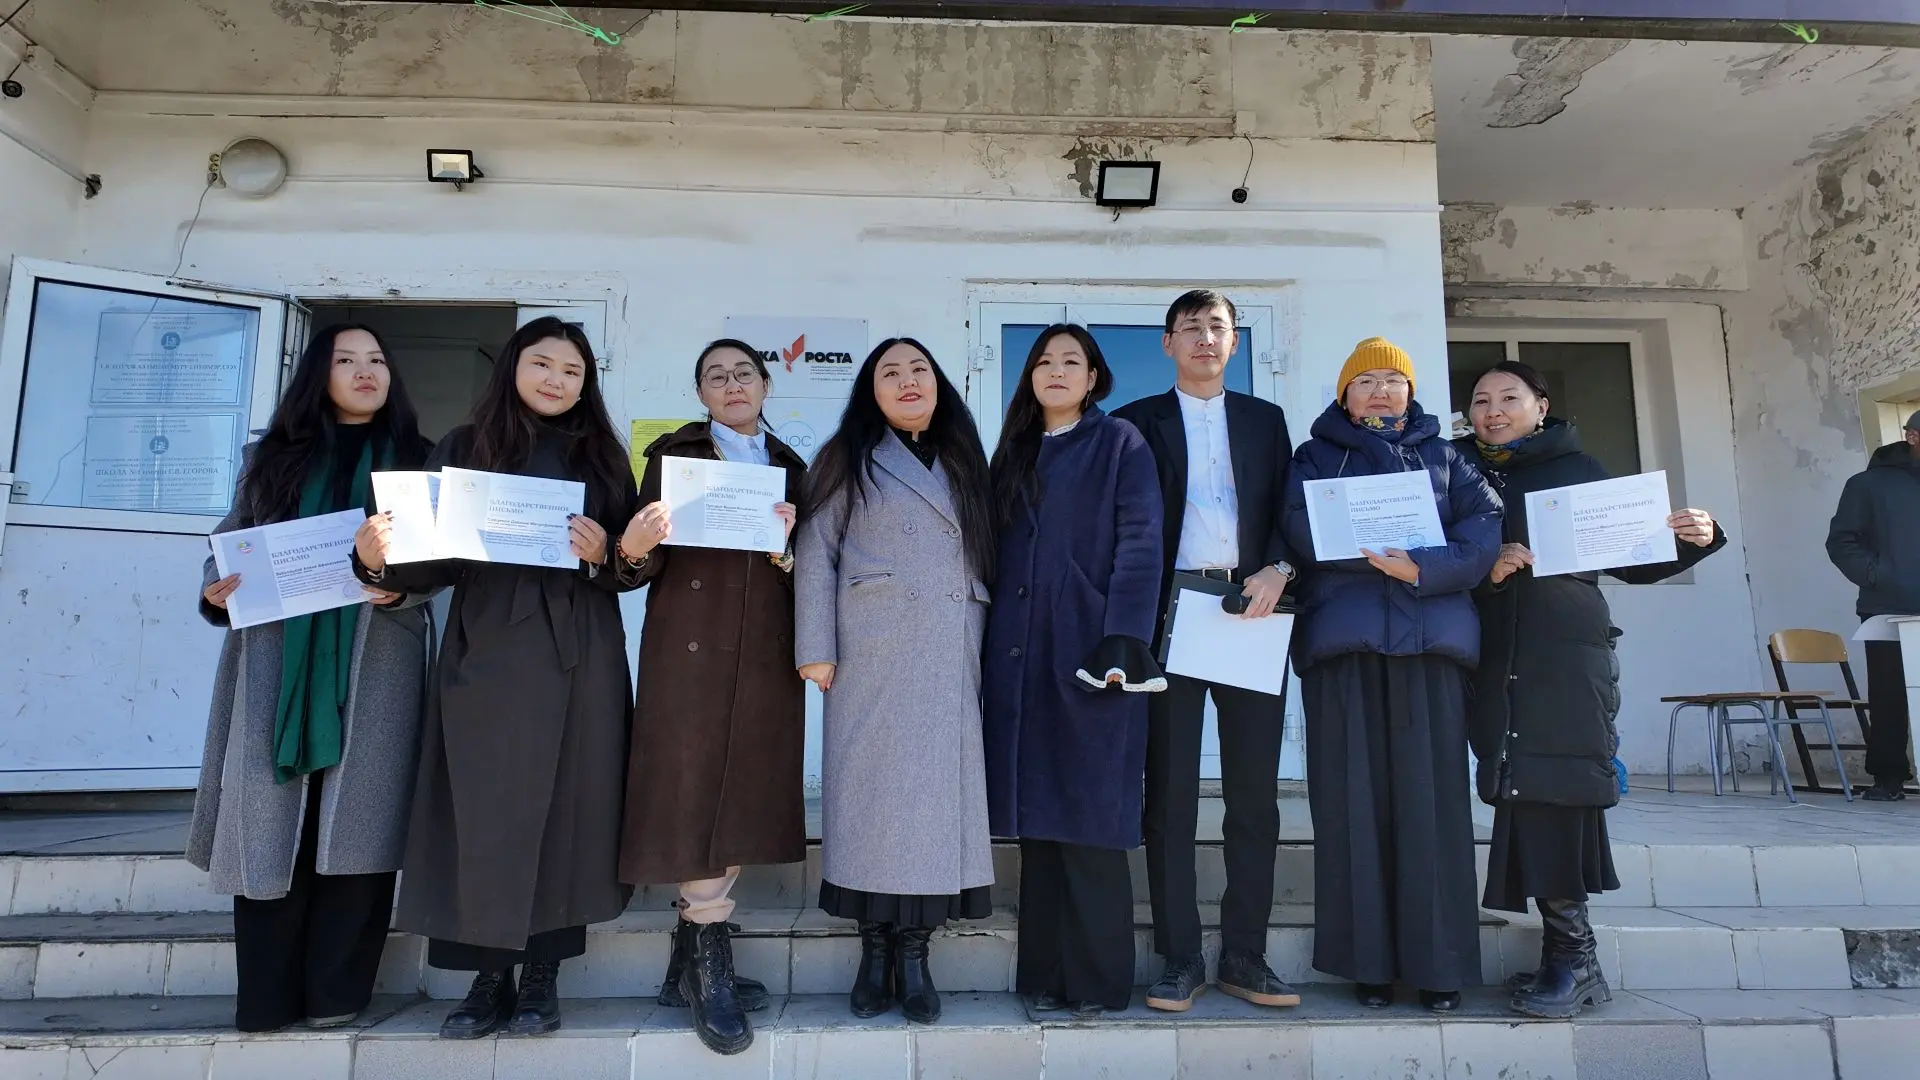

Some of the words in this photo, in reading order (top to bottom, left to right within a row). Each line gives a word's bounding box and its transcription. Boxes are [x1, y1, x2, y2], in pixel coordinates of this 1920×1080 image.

[756, 350, 780, 362] КА
[804, 351, 853, 364] РОСТА
[488, 506, 524, 515] ПИСЬМО
[1350, 505, 1381, 513] ПИСЬМО
[1573, 499, 1655, 516] БЛАГОДАРСТВЕННОЕ
[1574, 513, 1608, 522] ПИСЬМО
[273, 554, 310, 565] ПИСЬМО
